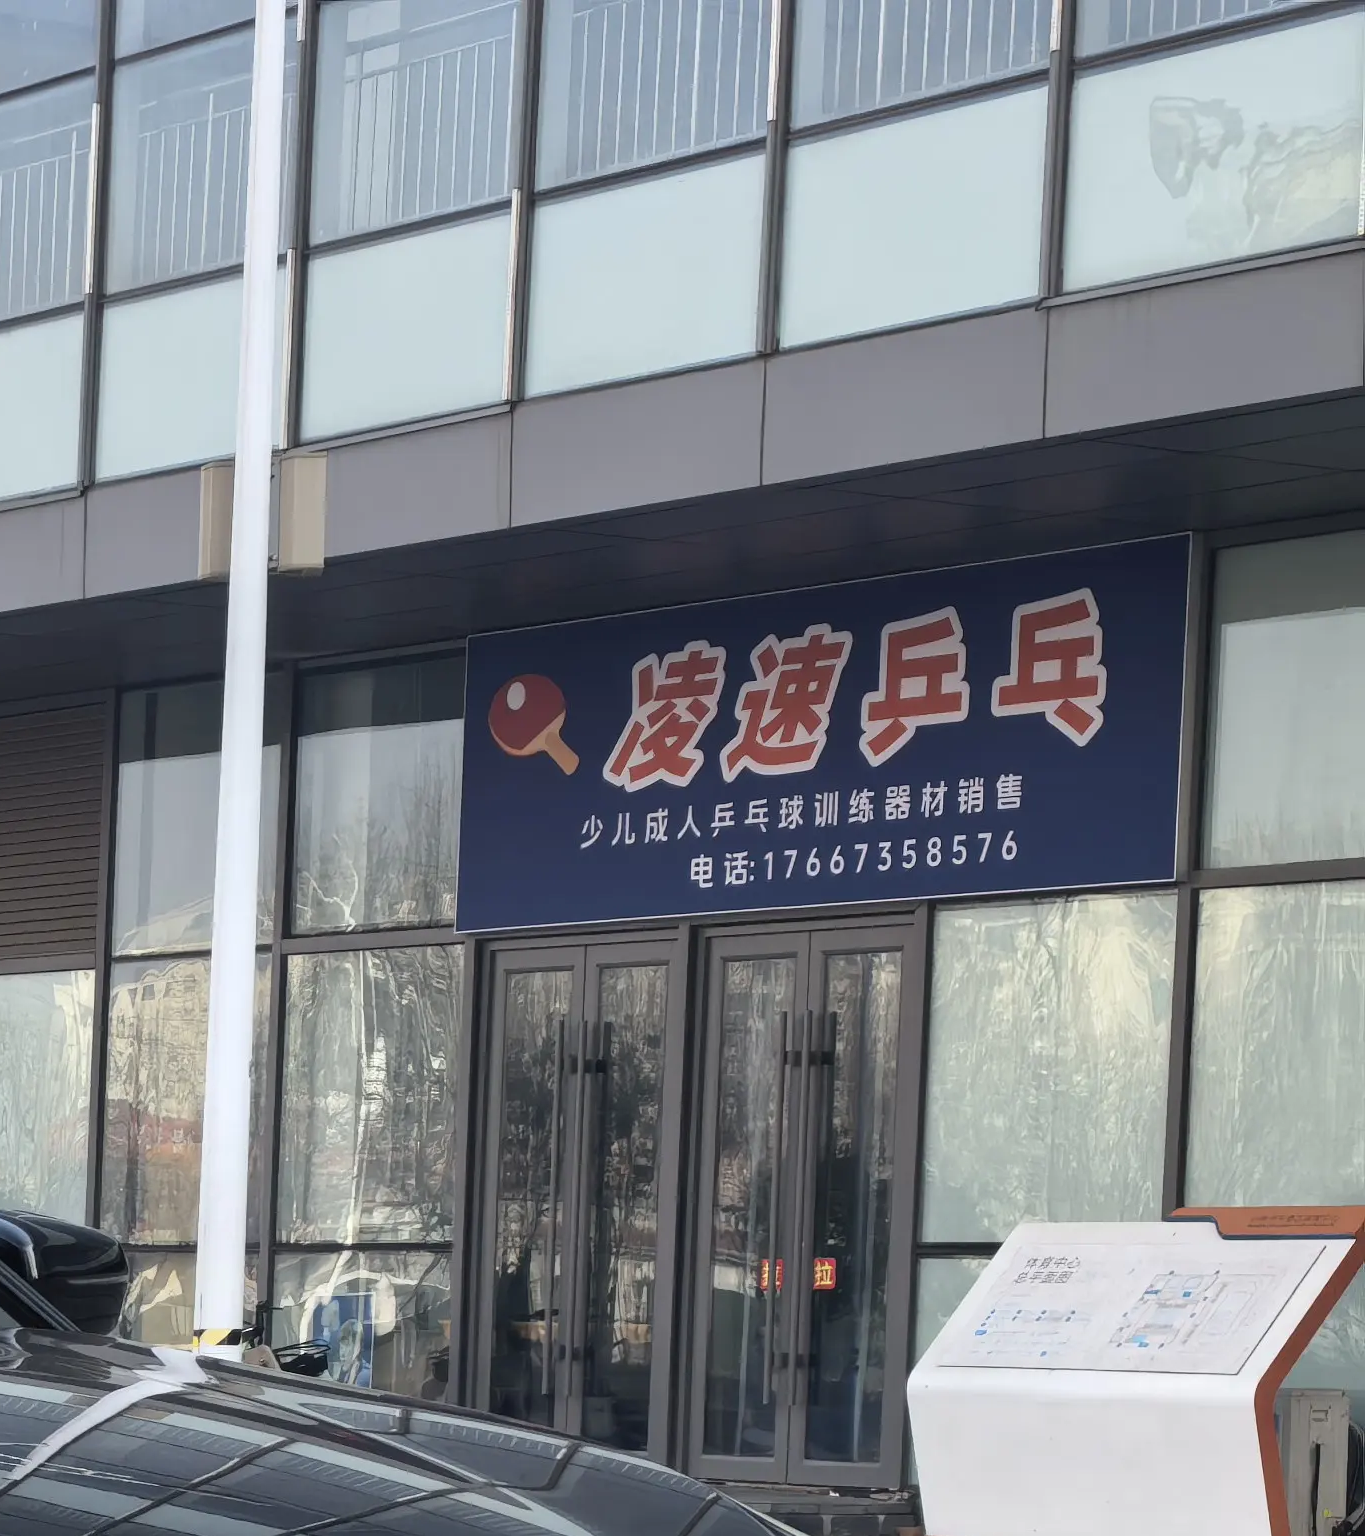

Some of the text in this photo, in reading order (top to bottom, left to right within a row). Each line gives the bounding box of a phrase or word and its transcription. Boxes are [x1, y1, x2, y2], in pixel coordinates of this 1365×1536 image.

[605, 589, 1107, 791] 凌速乒乓
[579, 772, 1024, 849] 少儿成人乒乓球训练器材销售
